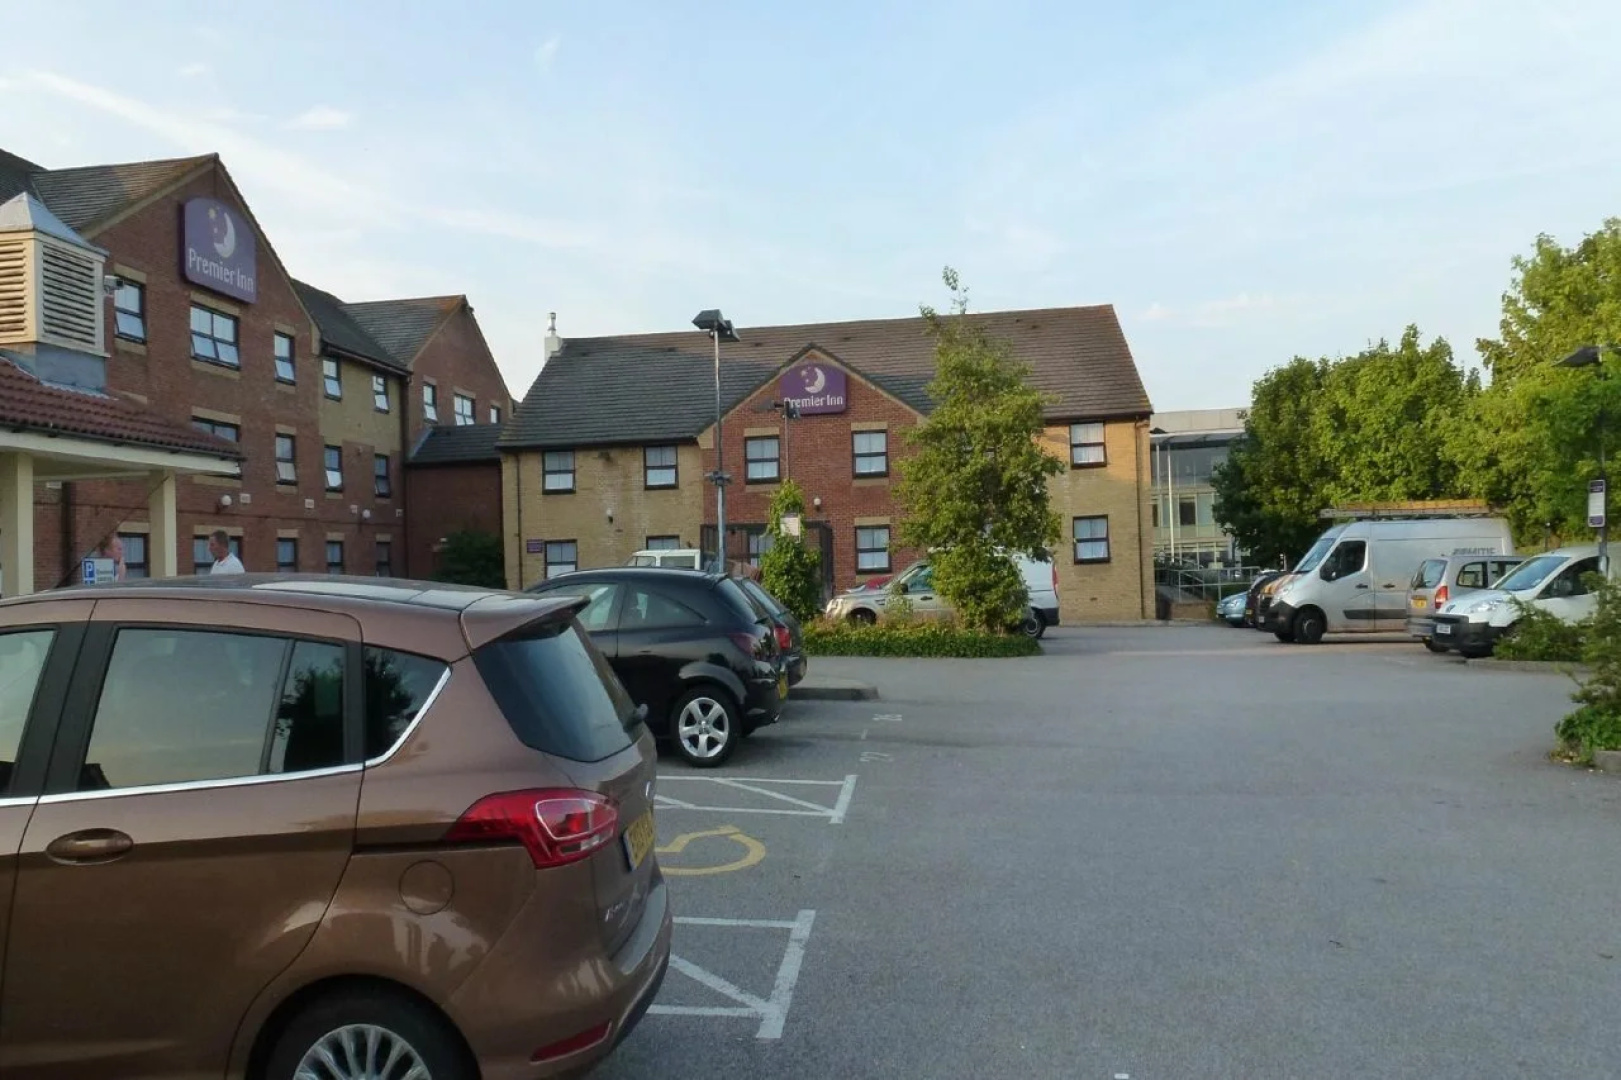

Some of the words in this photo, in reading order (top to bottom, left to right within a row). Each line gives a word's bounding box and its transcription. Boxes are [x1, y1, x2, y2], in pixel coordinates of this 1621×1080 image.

[189, 247, 235, 285] Premier
[237, 267, 254, 293] Inn
[826, 394, 843, 406] Inn
